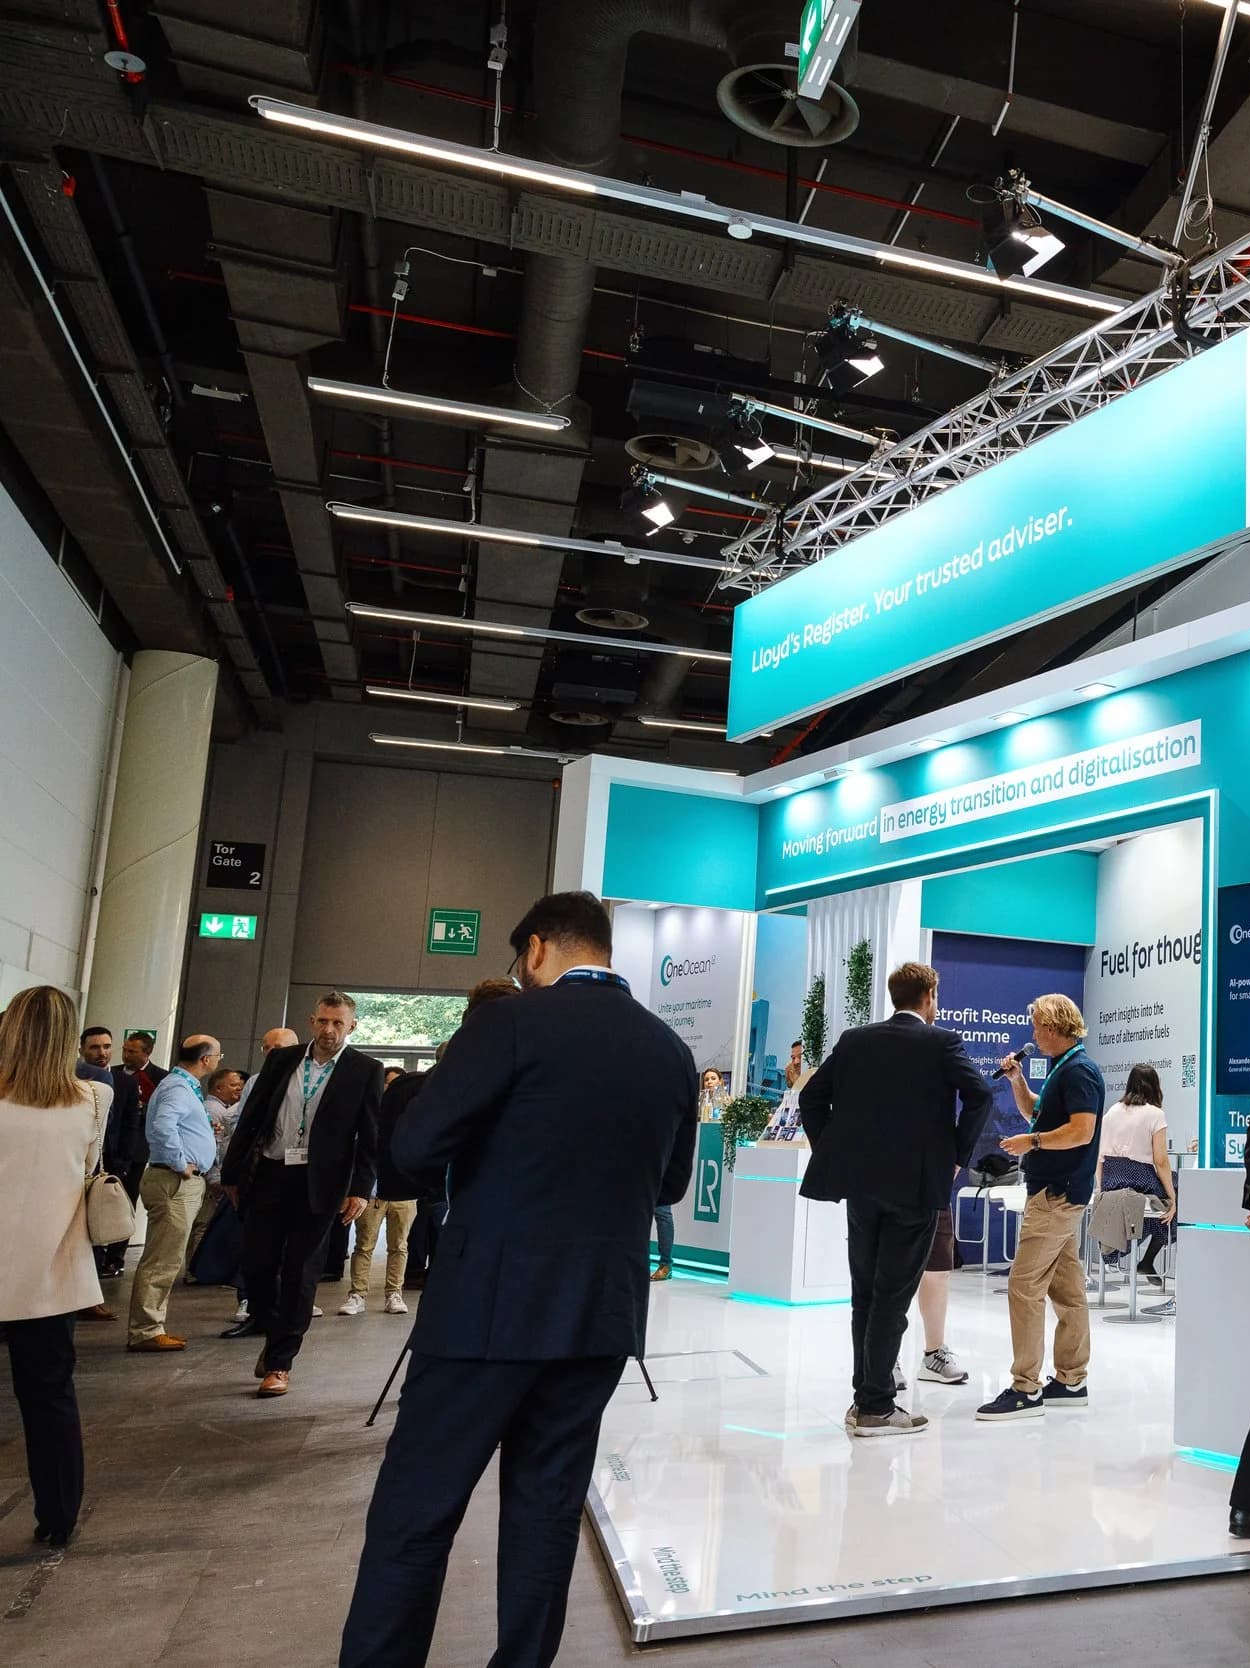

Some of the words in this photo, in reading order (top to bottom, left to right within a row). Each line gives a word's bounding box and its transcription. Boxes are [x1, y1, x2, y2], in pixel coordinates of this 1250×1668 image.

[751, 631, 801, 673] Lloyd's
[802, 604, 870, 649] Register.
[873, 580, 912, 615] Your
[915, 541, 984, 595] trusted
[987, 506, 1074, 562] adviser.
[782, 831, 824, 860] Moving
[825, 815, 878, 851] forward
[883, 812, 894, 833] in
[898, 801, 948, 829] energy
[950, 779, 1027, 817] transition
[1030, 766, 1065, 795] and
[1068, 732, 1197, 786] digitalisation
[214, 843, 236, 855] Tor
[212, 855, 242, 867] Gate
[249, 871, 261, 885] 2
[1101, 945, 1130, 978] Fuel
[1133, 941, 1154, 978] for
[1156, 928, 1202, 965] thoug
[665, 958, 713, 979] OneOcean
[1229, 991, 1239, 1000] for
[673, 1001, 685, 1015] your
[686, 998, 712, 1010] maritime
[935, 1007, 979, 1025] etrofit
[982, 1009, 1032, 1026] Resear
[1099, 1010, 1117, 1025] Expert
[1118, 1006, 1140, 1023] insights
[1140, 1004, 1153, 1017] into
[1154, 1002, 1164, 1015] the
[674, 1016, 695, 1029] journey
[1099, 1032, 1115, 1045] future
[1116, 1030, 1122, 1043] of
[1123, 1027, 1153, 1042] alternative
[1155, 1024, 1170, 1039] fuels
[697, 1159, 719, 1213] LR
[664, 1575, 691, 1595] step
[736, 1587, 809, 1602] Mind
[816, 1581, 865, 1594] the
[871, 1574, 933, 1587] step
